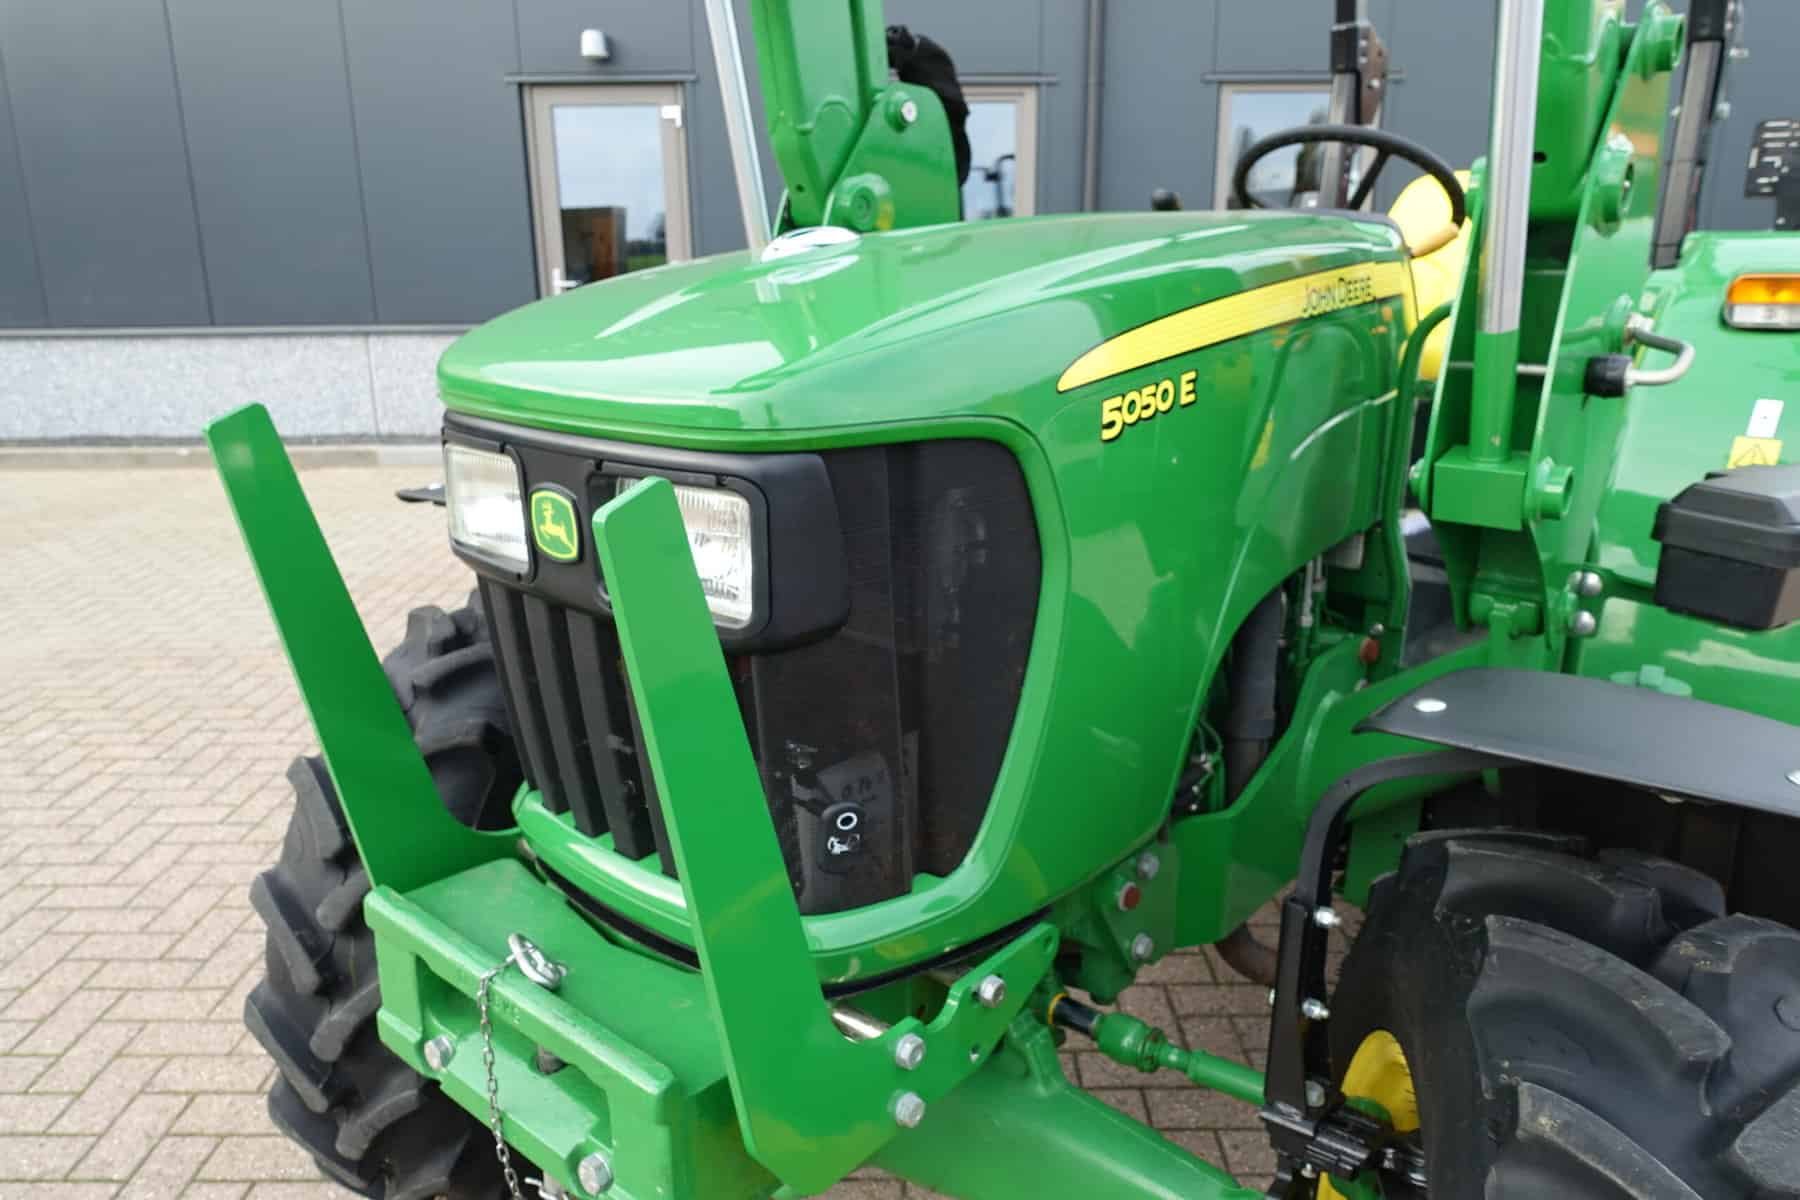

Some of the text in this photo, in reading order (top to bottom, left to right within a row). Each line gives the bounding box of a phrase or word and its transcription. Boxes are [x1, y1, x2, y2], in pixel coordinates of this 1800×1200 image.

[1303, 275, 1373, 316] JOHN DEERE
[1101, 369, 1197, 442] 5050 E
